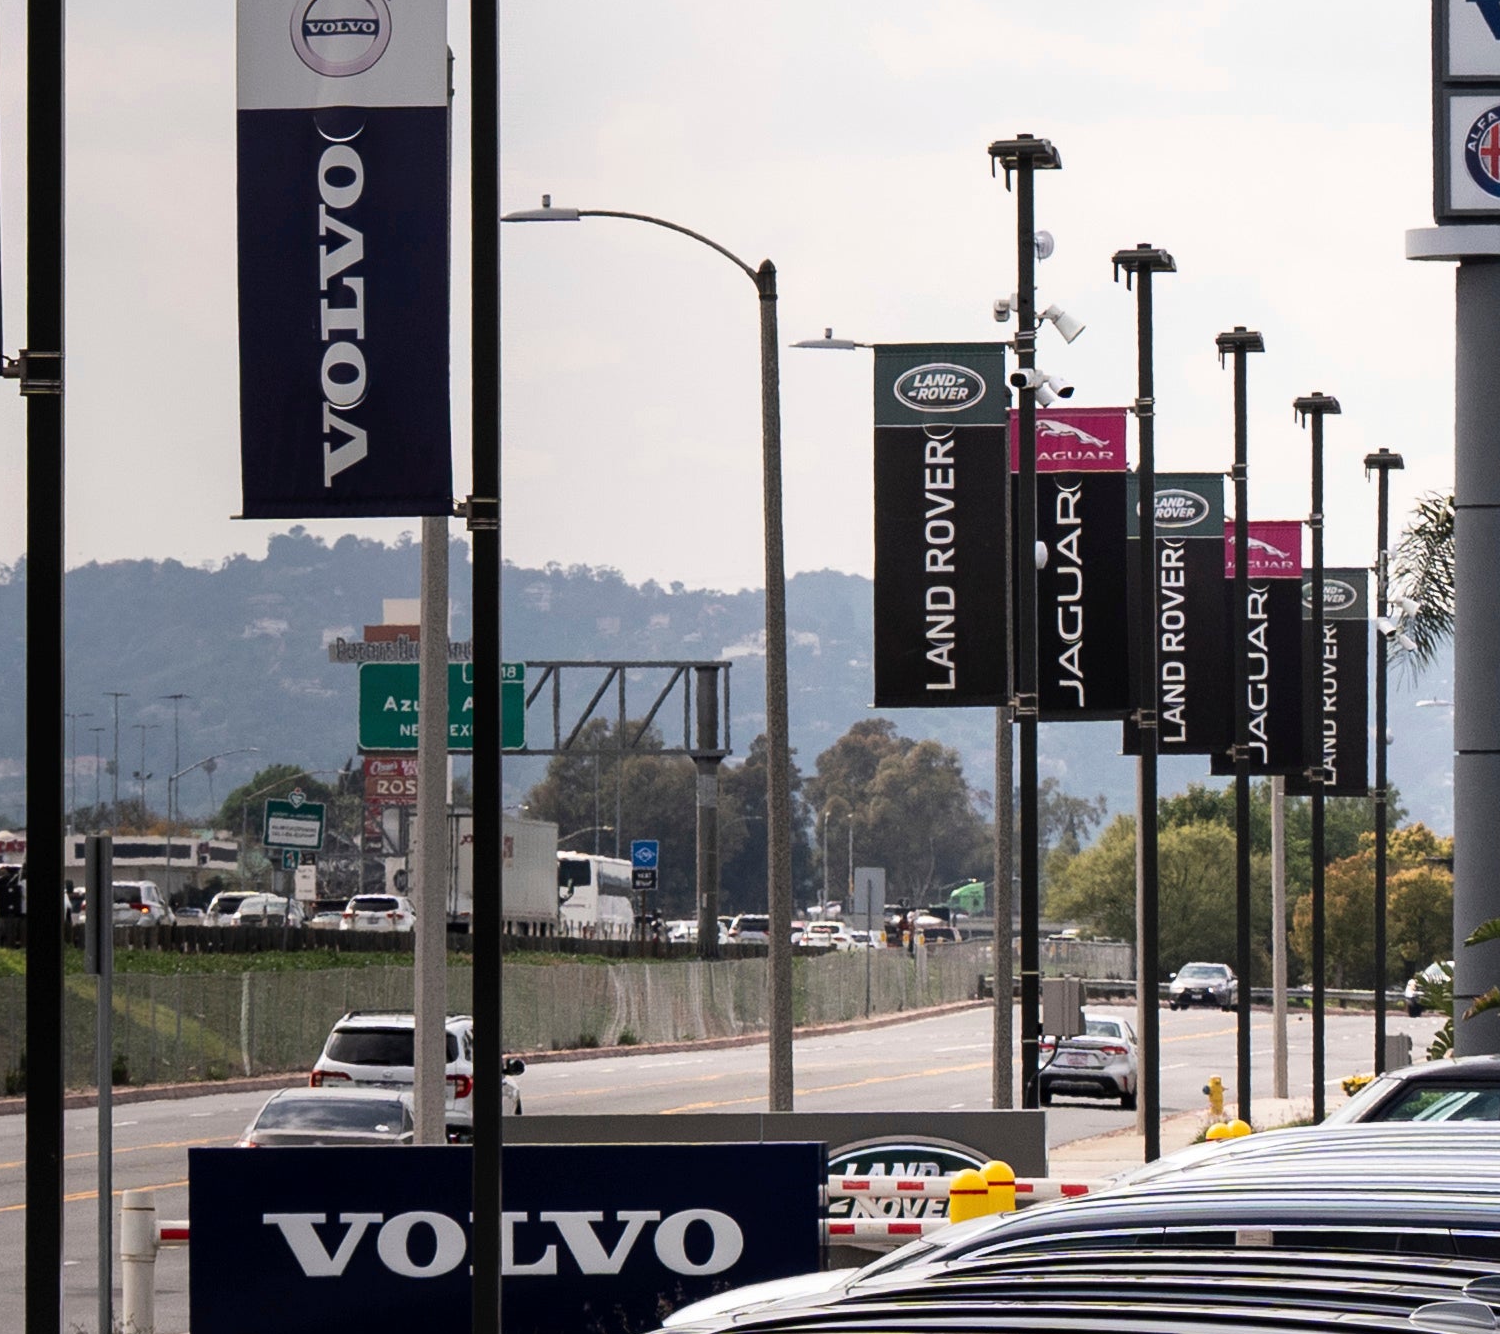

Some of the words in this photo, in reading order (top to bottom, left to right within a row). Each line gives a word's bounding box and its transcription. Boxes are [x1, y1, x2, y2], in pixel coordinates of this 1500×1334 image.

[305, 18, 377, 36] VOLVO
[1466, 111, 1500, 153] ALFA
[316, 143, 370, 488] VOLVO
[913, 373, 957, 388] LAND
[917, 386, 970, 401] ROVER
[1037, 450, 1114, 462] AGUAR
[924, 435, 956, 574] ROVER
[1226, 560, 1295, 570] JGUAR
[1056, 489, 1085, 709] JAGUAR
[1161, 547, 1186, 653] ROVER
[925, 586, 957, 692] LAND
[1162, 665, 1186, 744] LAND
[1247, 590, 1270, 765] JAGUAR
[376, 780, 417, 795] ROS
[850, 1197, 951, 1219] ROVE
[262, 1207, 744, 1278] VOLVO
